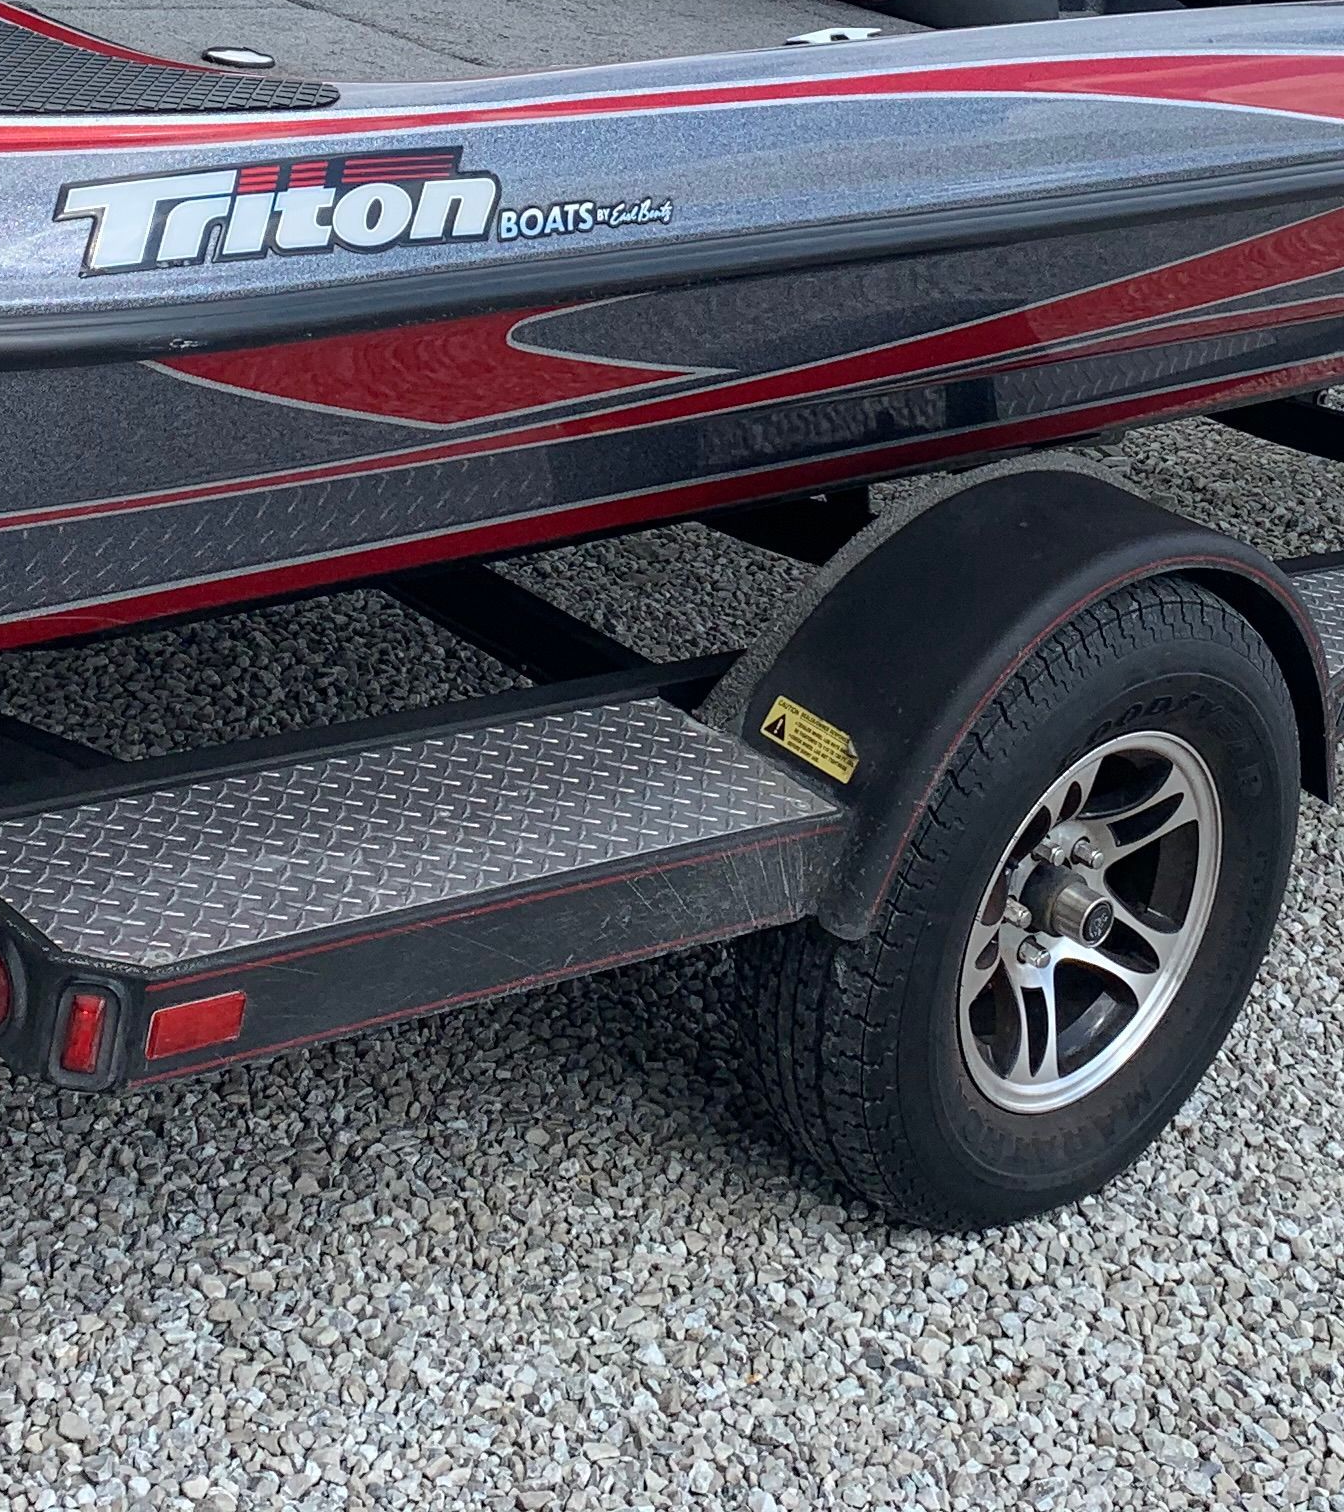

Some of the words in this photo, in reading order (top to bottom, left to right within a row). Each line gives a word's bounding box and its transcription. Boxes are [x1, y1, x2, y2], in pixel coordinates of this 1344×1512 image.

[59, 167, 498, 271] Triton
[500, 202, 595, 239] BOATS
[596, 206, 611, 223] BY
